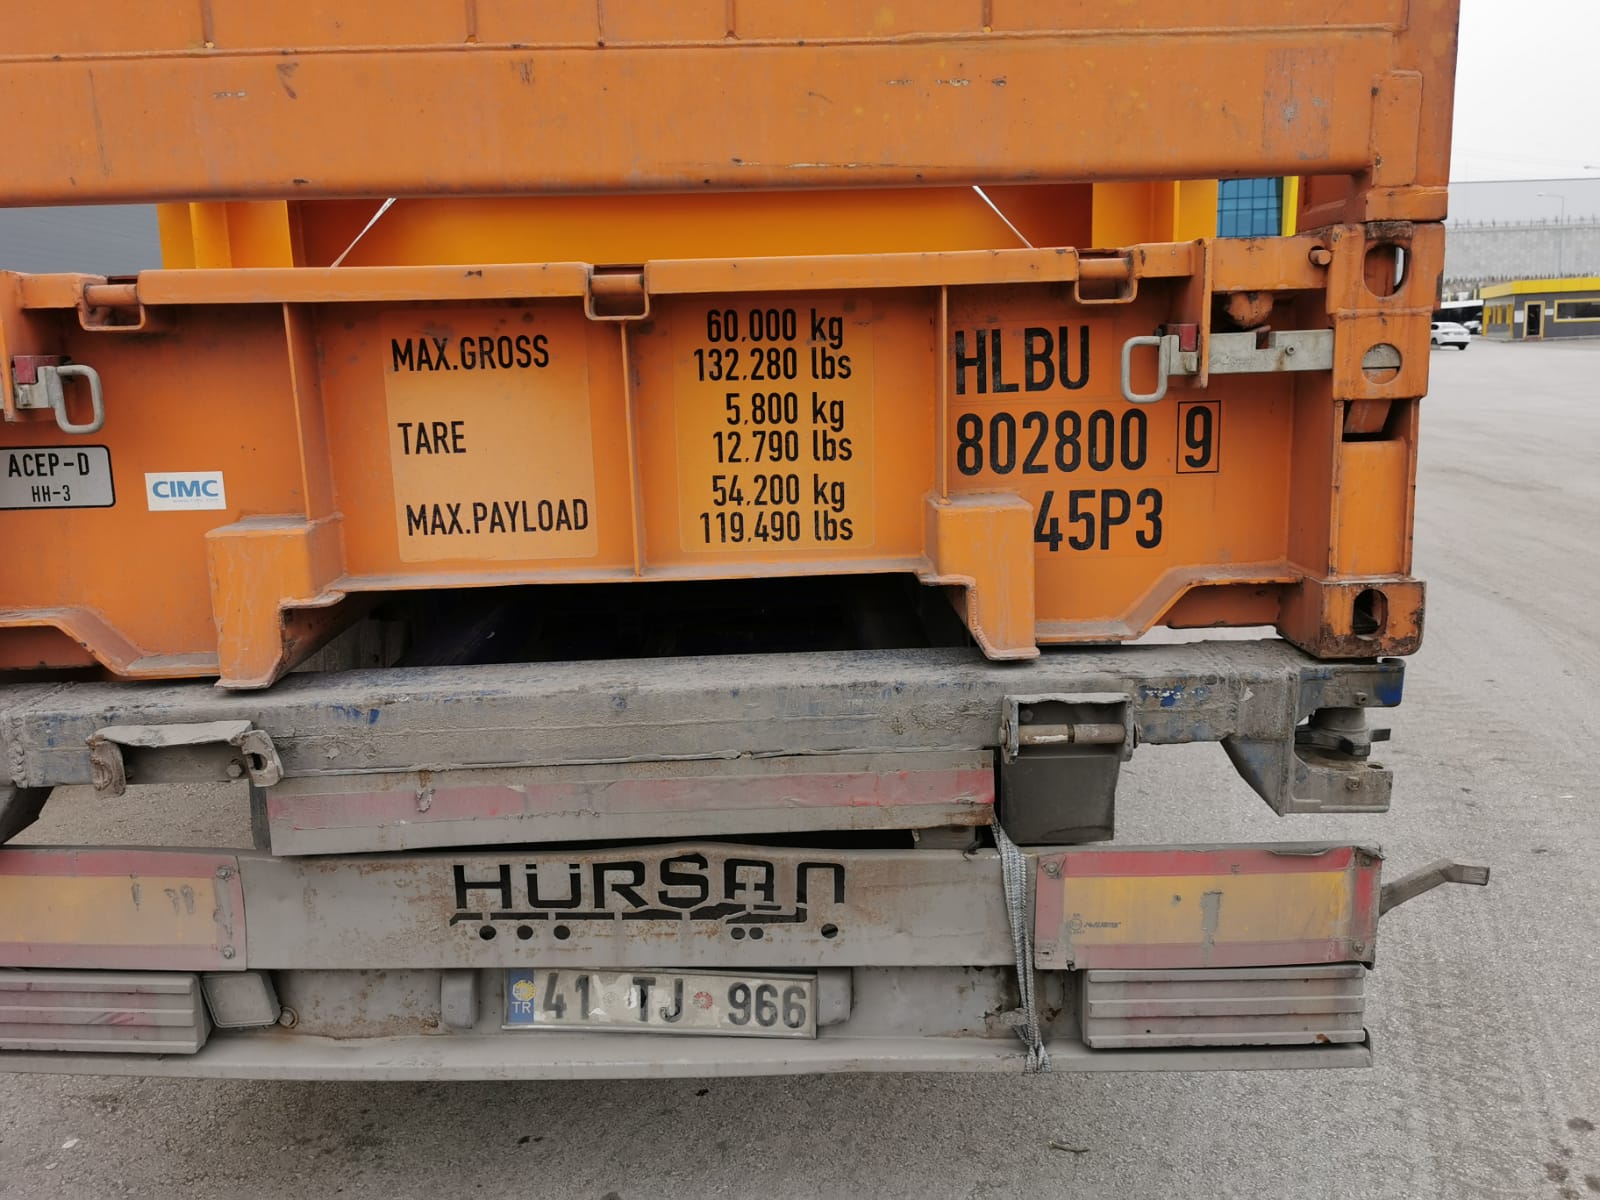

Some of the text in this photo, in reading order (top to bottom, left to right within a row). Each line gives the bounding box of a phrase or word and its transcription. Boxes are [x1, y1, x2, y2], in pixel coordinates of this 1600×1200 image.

[810, 308, 843, 349] kg
[391, 334, 549, 372] MAX.GROSS
[811, 346, 852, 379] lbs
[955, 325, 1089, 394] HLBU
[812, 392, 844, 432] kg
[397, 421, 466, 455] TARE
[812, 430, 853, 461] lbs
[957, 405, 1212, 476] 802800 9
[8, 452, 90, 477] ACEP-D
[32, 485, 71, 502] HH-3
[152, 480, 219, 498] CIMC
[813, 473, 845, 513] kg
[406, 498, 588, 536] MAX.PAYLOAD
[814, 510, 853, 541] lbs
[1034, 488, 1163, 551] 45P3
[453, 853, 845, 910] HÜRSAN
[512, 1001, 531, 1014] TR
[543, 972, 806, 1028] 41 TJ 966
